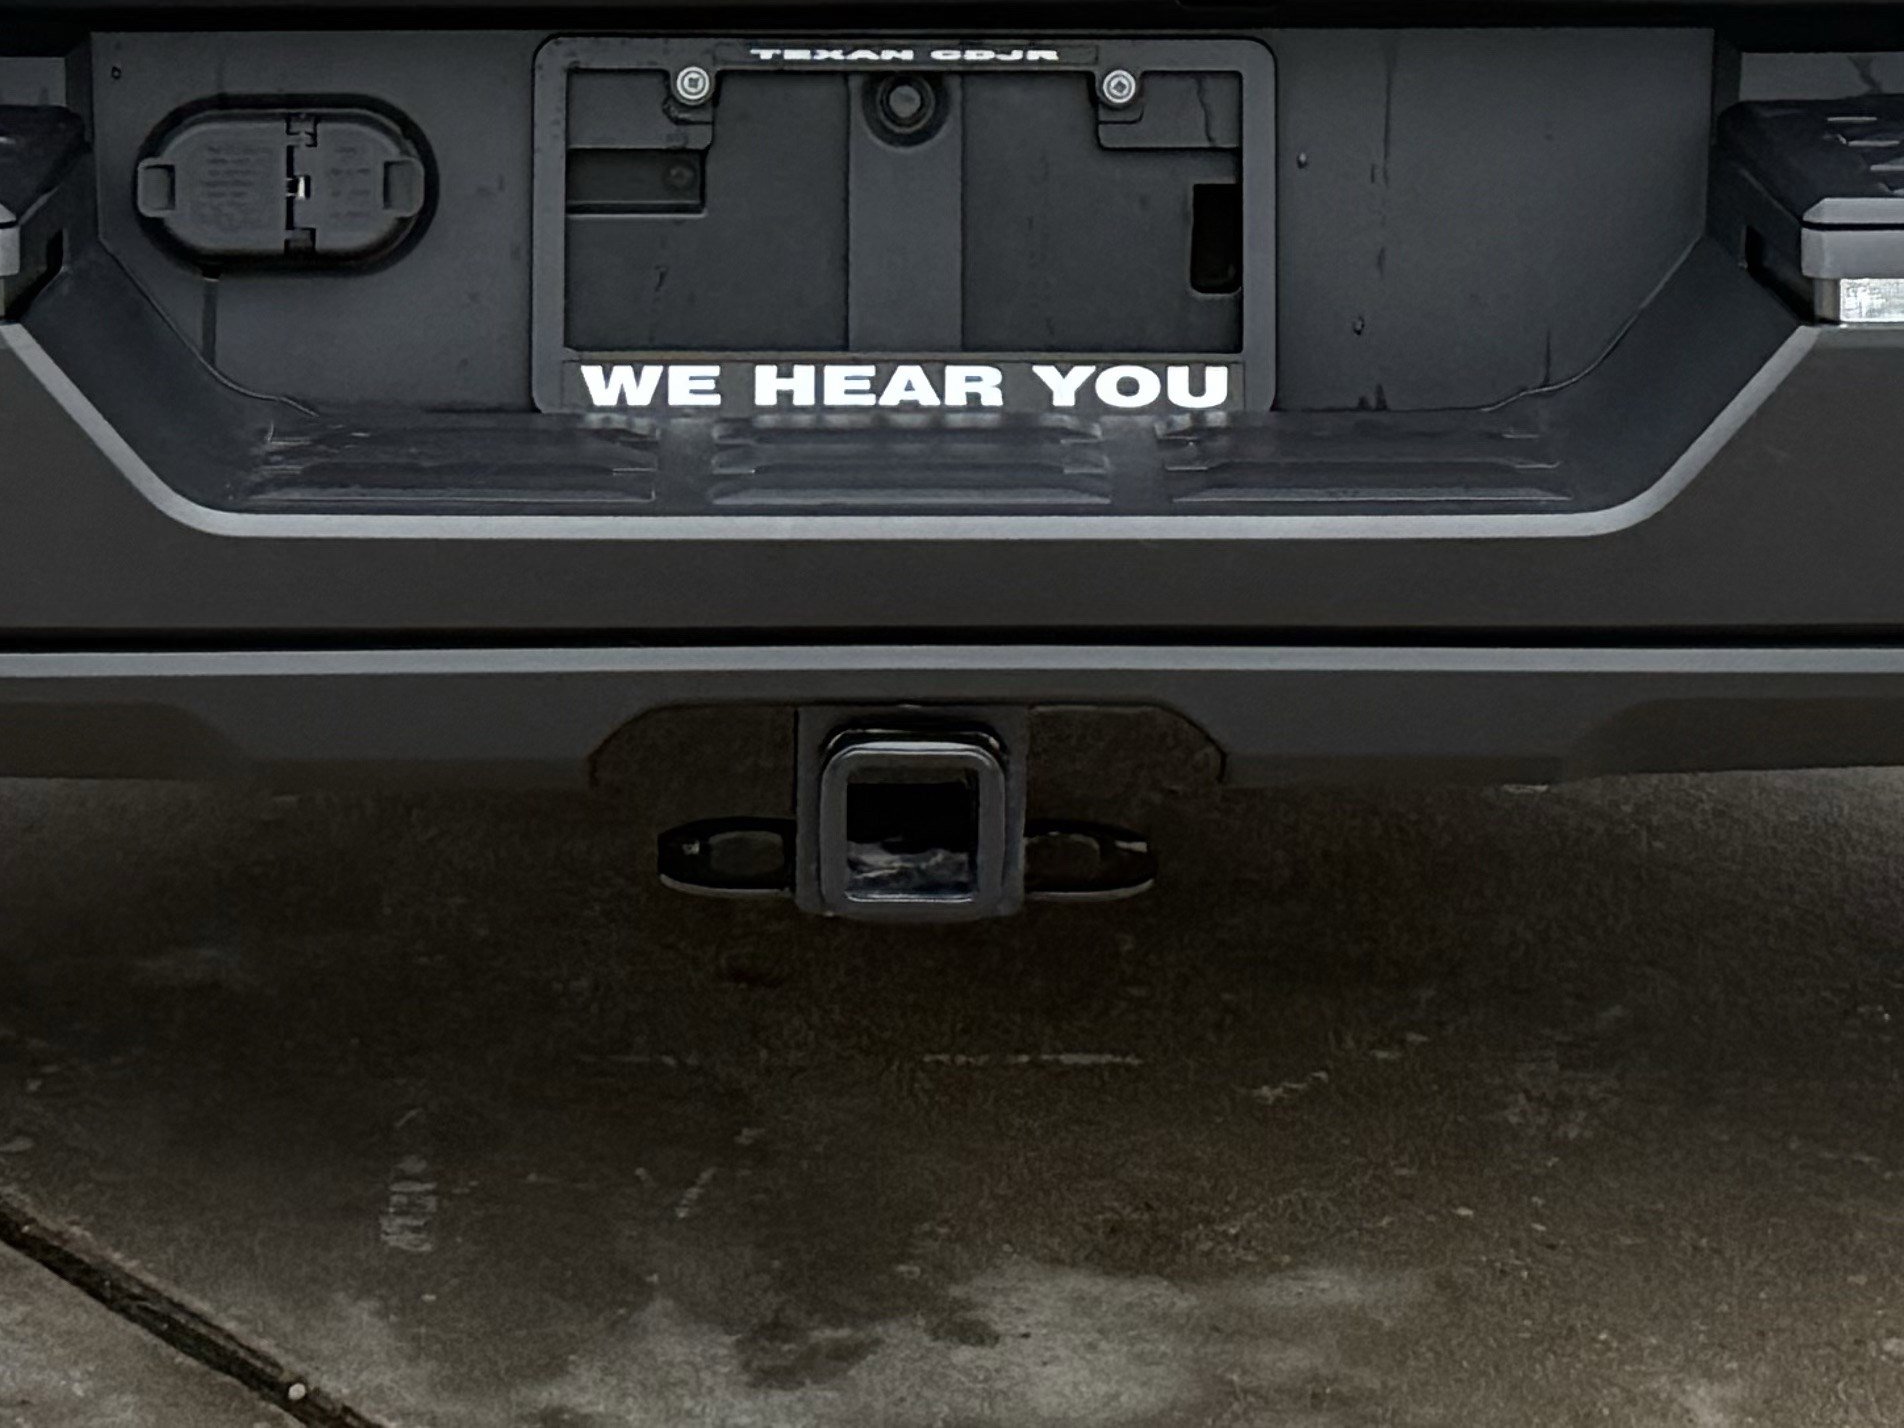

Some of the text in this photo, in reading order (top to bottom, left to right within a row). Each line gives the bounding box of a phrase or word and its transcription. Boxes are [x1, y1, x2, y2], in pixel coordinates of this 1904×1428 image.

[750, 49, 914, 61] TEXAN
[581, 364, 1229, 408] WE HEAR YOU
